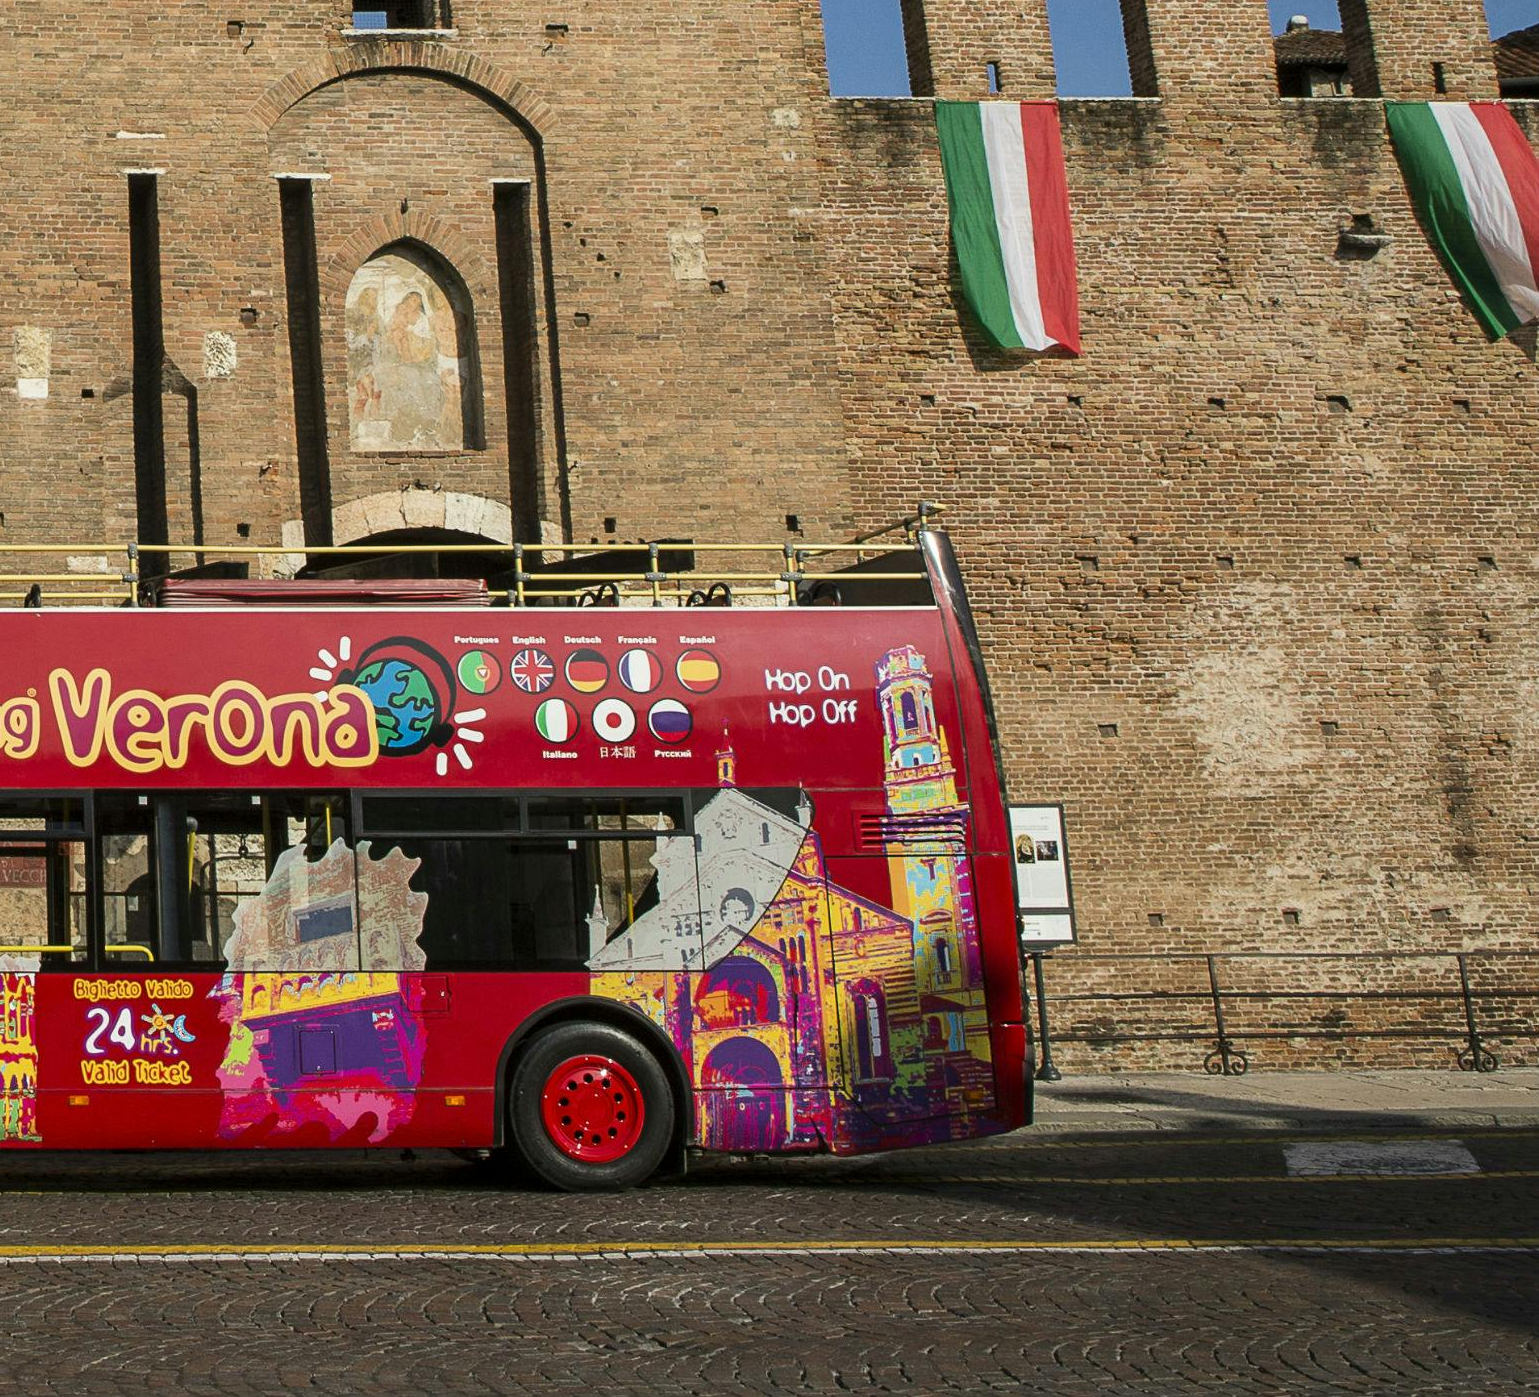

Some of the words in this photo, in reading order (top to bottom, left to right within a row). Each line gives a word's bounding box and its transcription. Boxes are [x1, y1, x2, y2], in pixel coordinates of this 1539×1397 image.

[512, 636, 546, 645] English
[564, 636, 601, 644] Deutsch
[617, 636, 657, 645] Français
[679, 635, 716, 645] Español
[765, 669, 811, 695] Hop
[818, 666, 850, 691] On
[48, 668, 379, 773] Verona
[769, 701, 816, 728] Hop
[822, 699, 859, 724] Off
[542, 750, 579, 759] Italiano
[599, 746, 636, 759] 日本語
[654, 749, 692, 758] Русский
[73, 979, 142, 1002] Biglietto
[145, 979, 194, 999] Valido
[85, 1007, 136, 1054] 24
[141, 1033, 179, 1054] hrs.
[81, 1060, 130, 1084] Valid
[133, 1059, 192, 1085] Ticket
